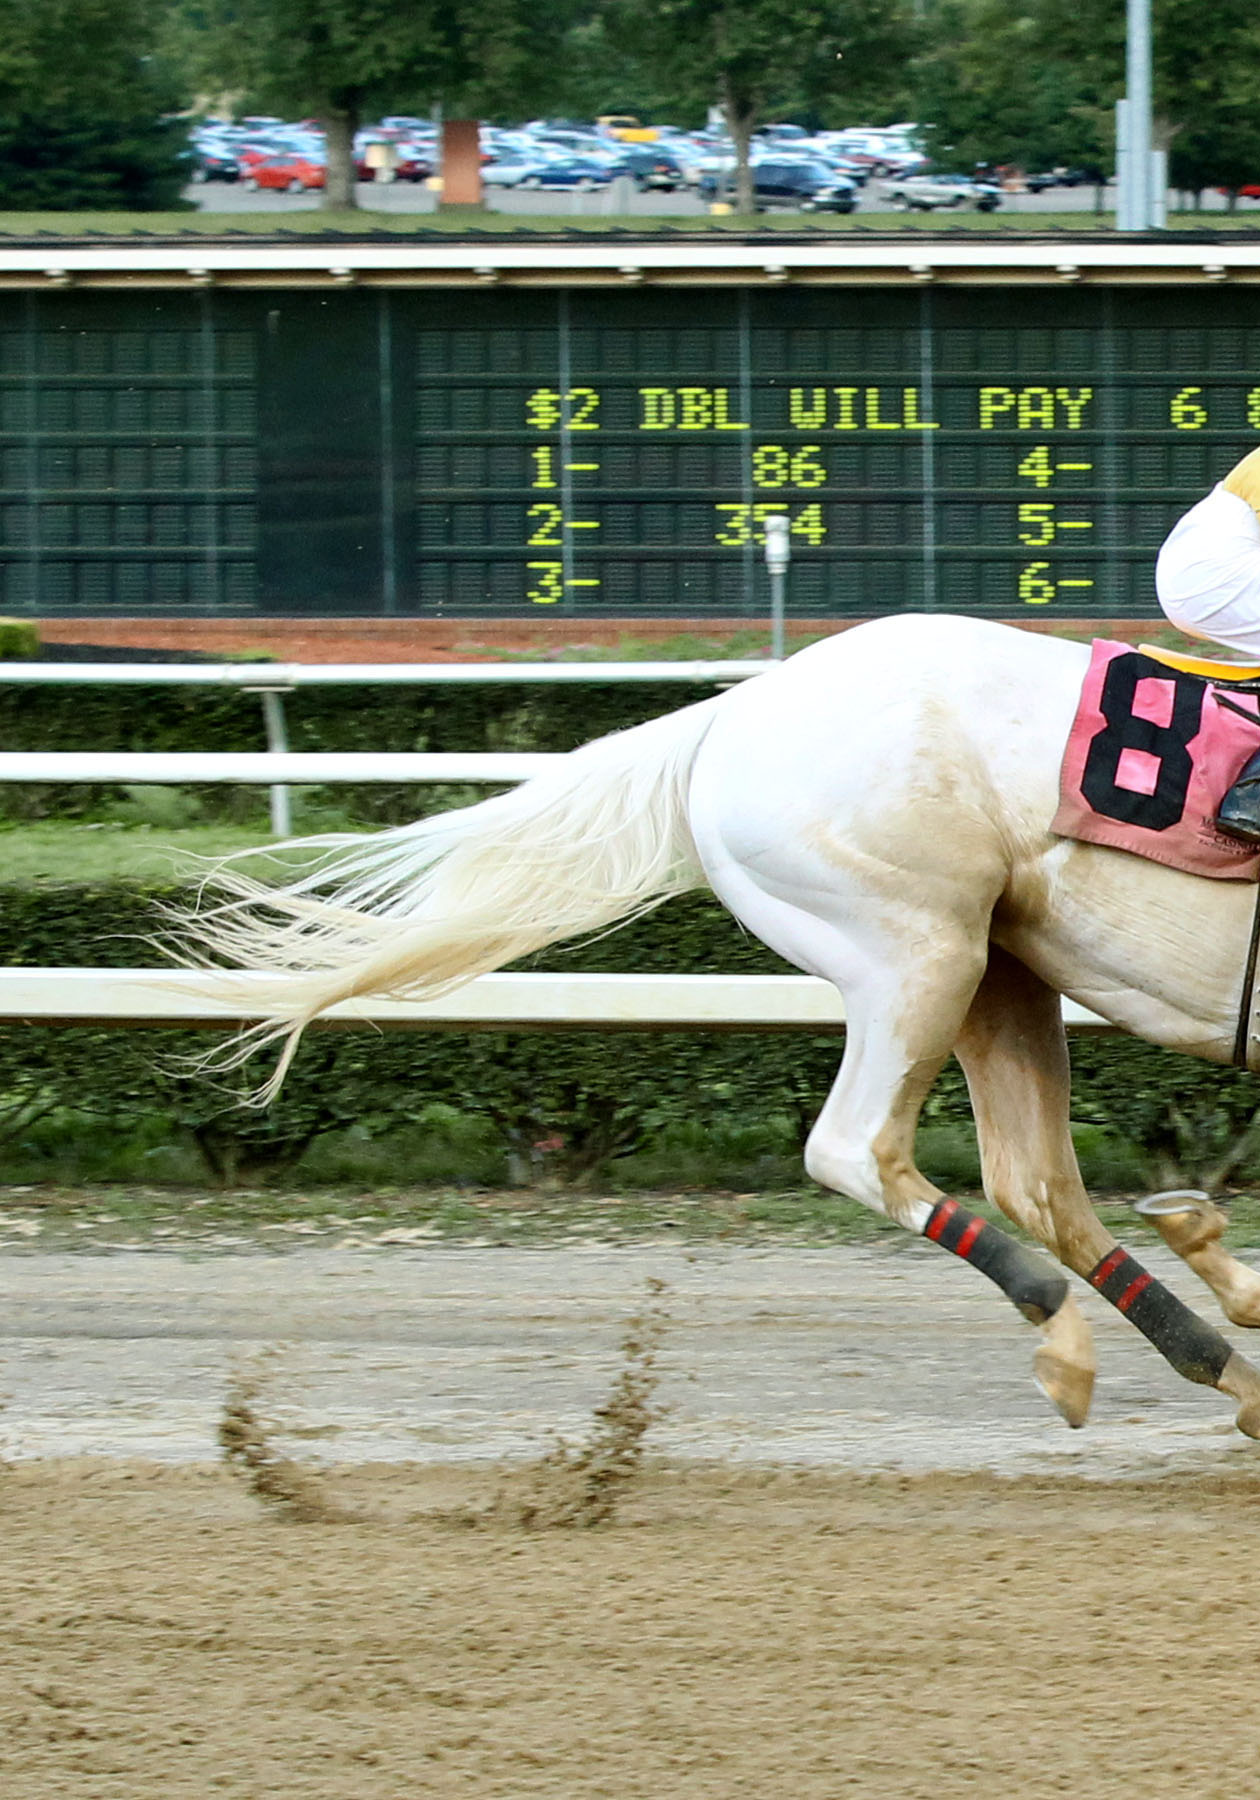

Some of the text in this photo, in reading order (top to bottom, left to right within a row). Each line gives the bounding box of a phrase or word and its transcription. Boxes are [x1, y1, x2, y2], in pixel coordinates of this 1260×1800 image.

[526, 387, 600, 431] $2
[638, 387, 751, 431] DBL
[789, 387, 941, 431] WILL
[979, 387, 1093, 431] PAY
[1170, 386, 1208, 431] 6
[531, 445, 1094, 489] 1- 86 4-
[527, 503, 1094, 547] 2- 354 5-
[527, 561, 1094, 605] 3- 6-
[1080, 651, 1207, 831] 8
